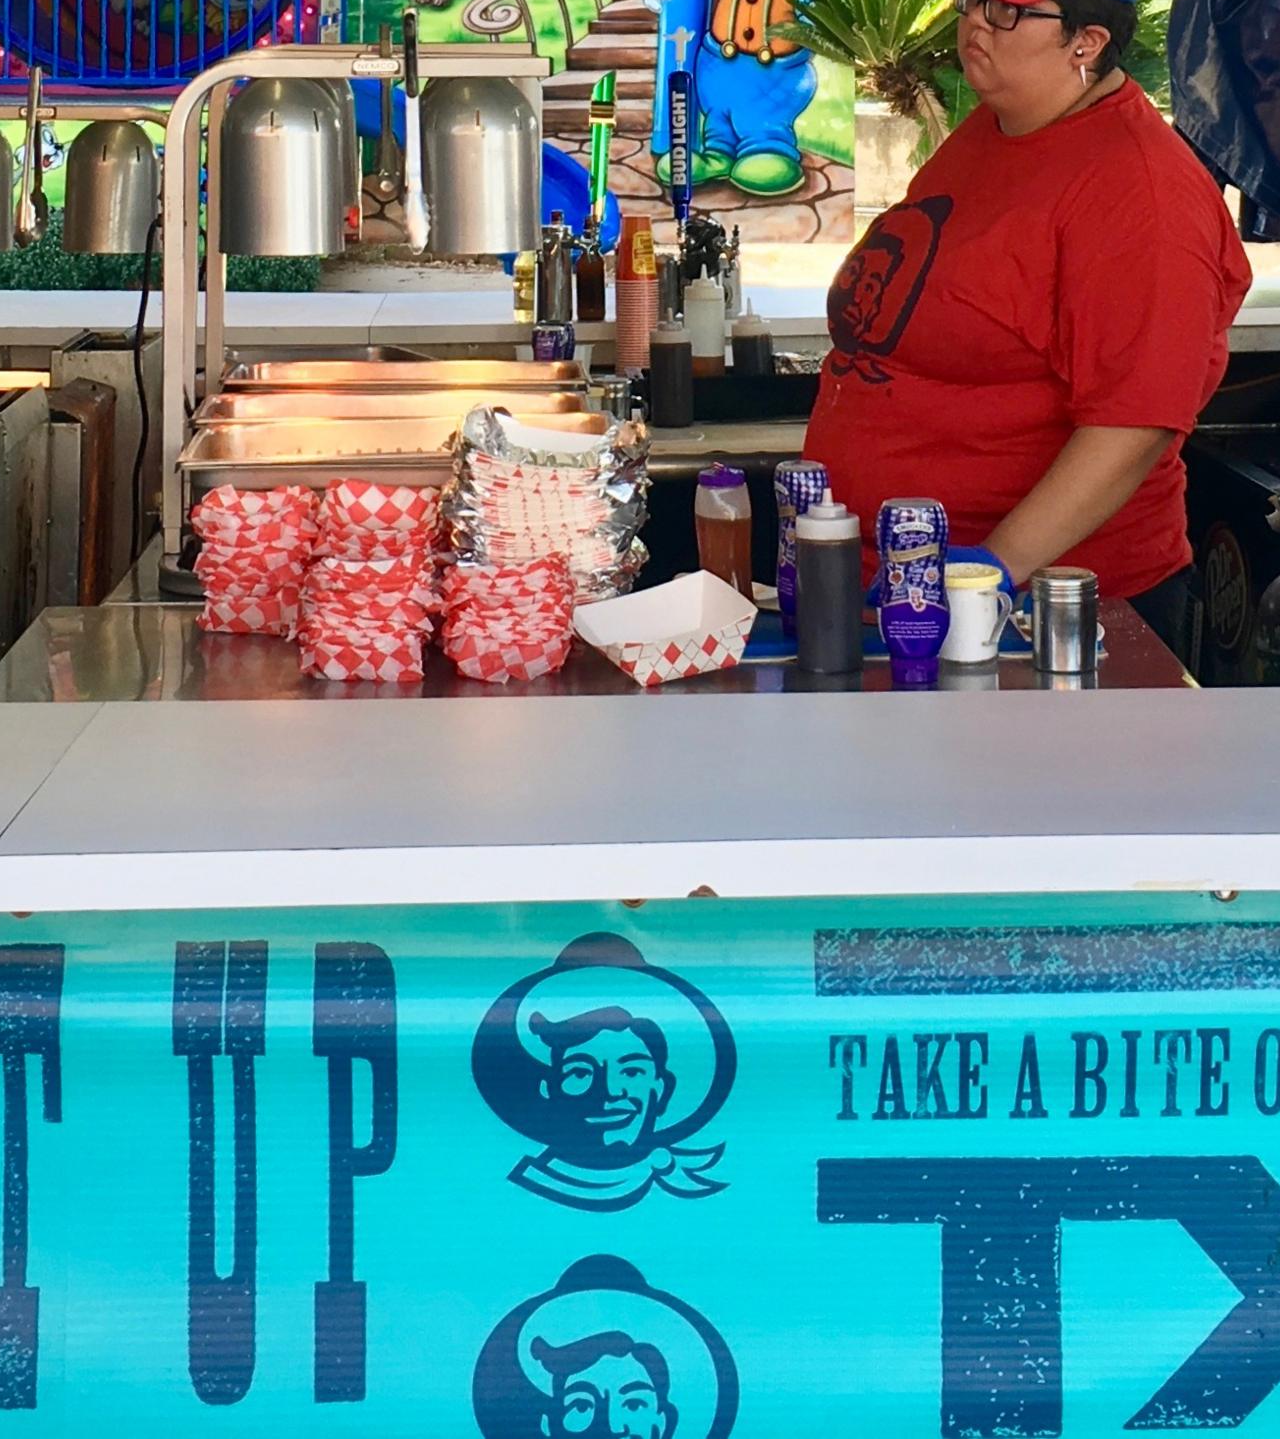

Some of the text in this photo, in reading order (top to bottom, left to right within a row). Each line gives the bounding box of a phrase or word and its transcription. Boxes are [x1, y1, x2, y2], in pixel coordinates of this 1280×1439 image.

[672, 91, 687, 186] BUD LIGHT
[829, 1032, 990, 1122] TAKE
[1009, 1032, 1049, 1118] A
[1069, 1028, 1231, 1118] BITE
[171, 940, 399, 1407] UP
